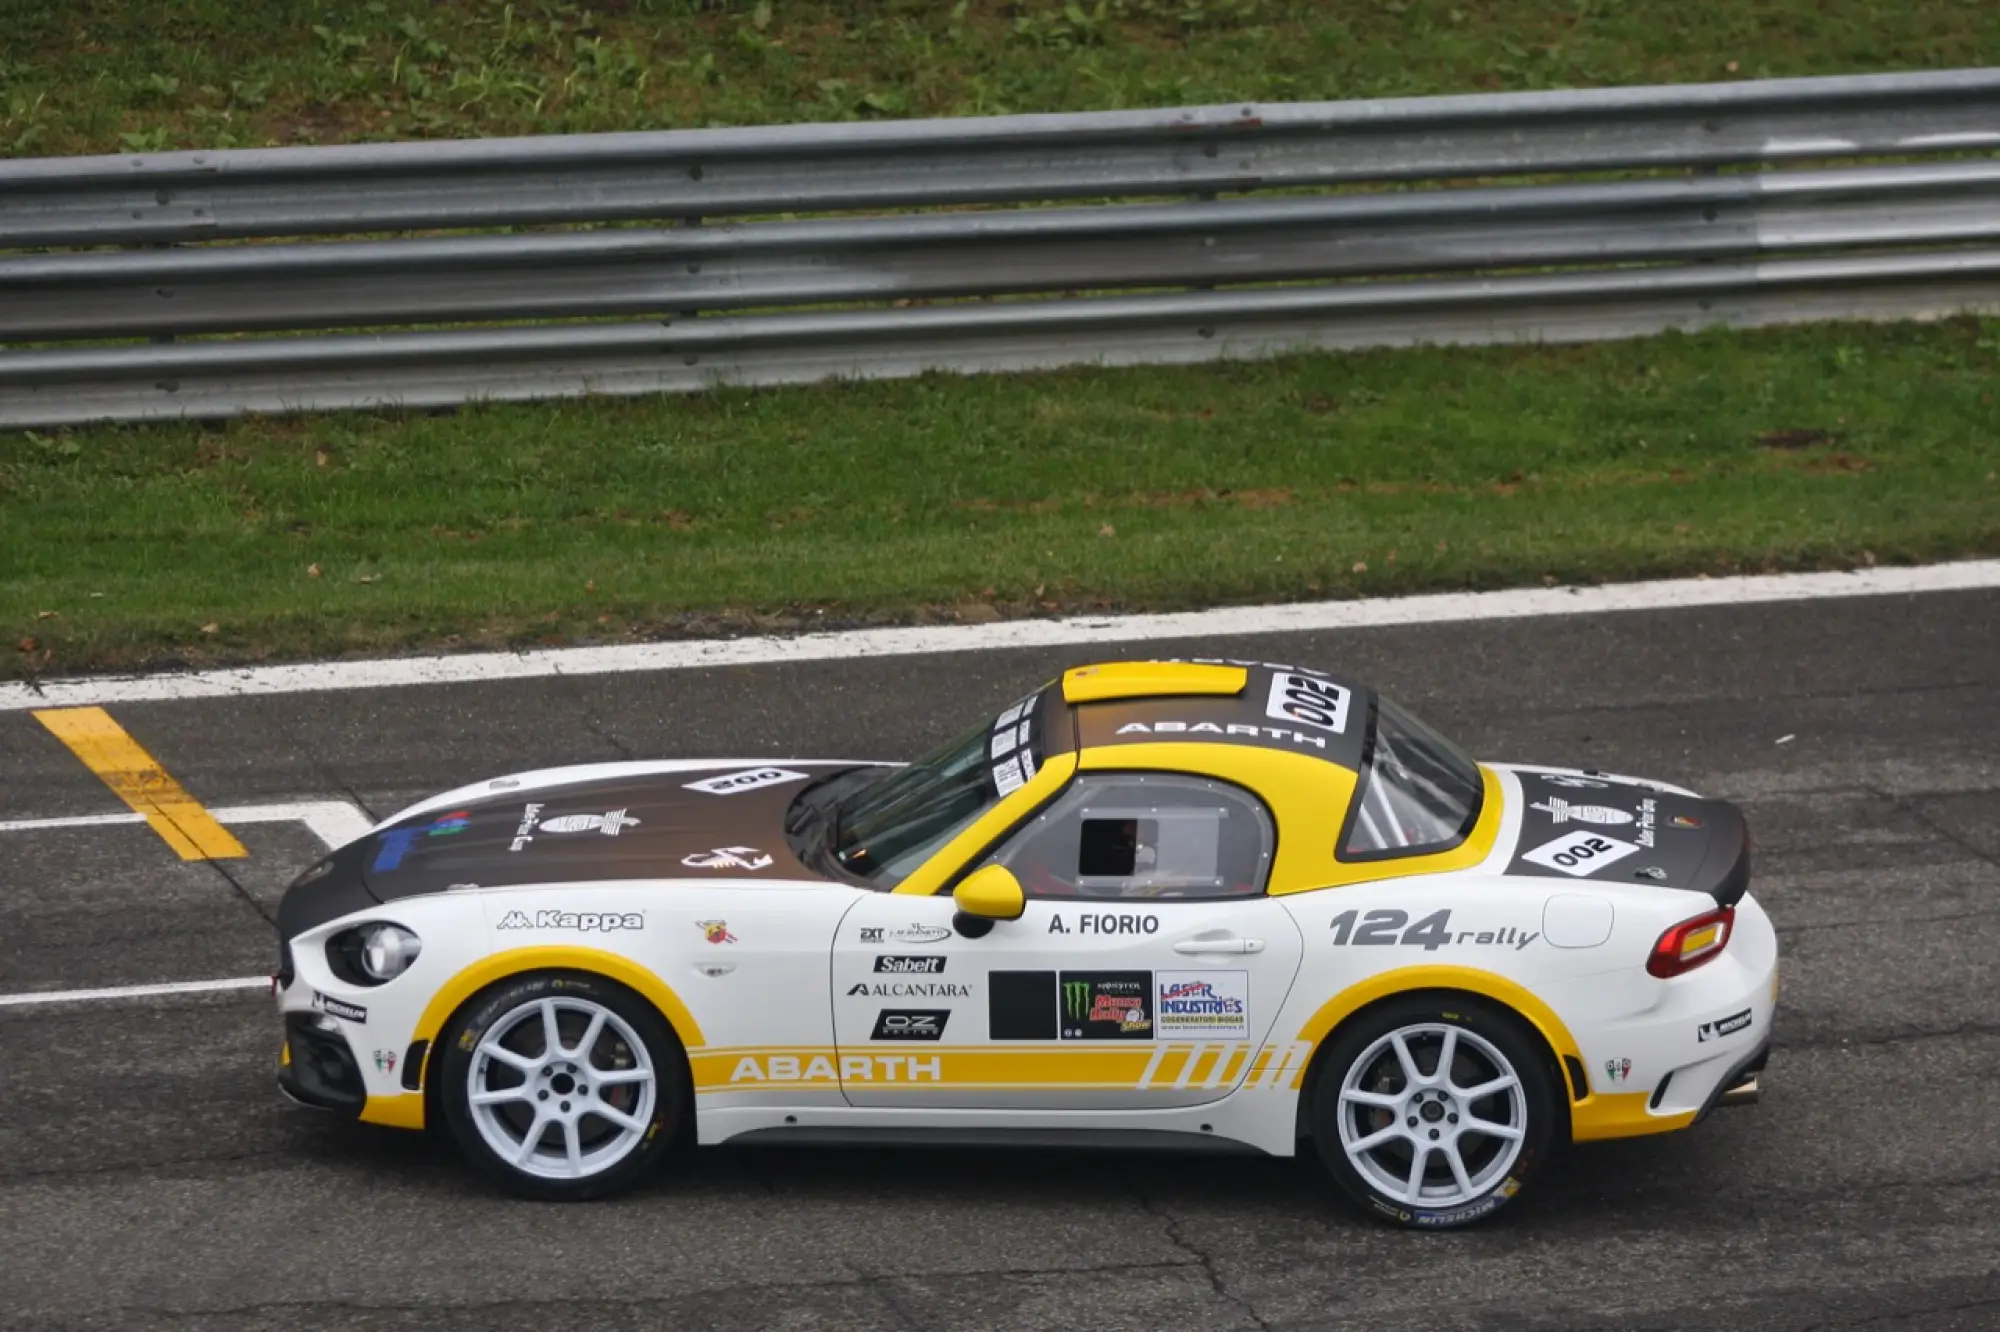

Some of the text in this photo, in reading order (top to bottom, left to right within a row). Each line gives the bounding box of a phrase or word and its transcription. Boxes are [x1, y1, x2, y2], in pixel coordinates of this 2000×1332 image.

[1282, 676, 1340, 727] 002
[1116, 722, 1326, 748] ABARTH
[1553, 838, 1613, 867] 002
[536, 910, 643, 931] Kappa
[1048, 914, 1160, 935] A. FIORIO
[1330, 908, 1540, 951] 124 rally
[880, 956, 940, 973] Sabelt
[872, 983, 970, 997] ALCANTARA
[1160, 981, 1217, 1000] LASER
[730, 1056, 941, 1081] ABARTH
